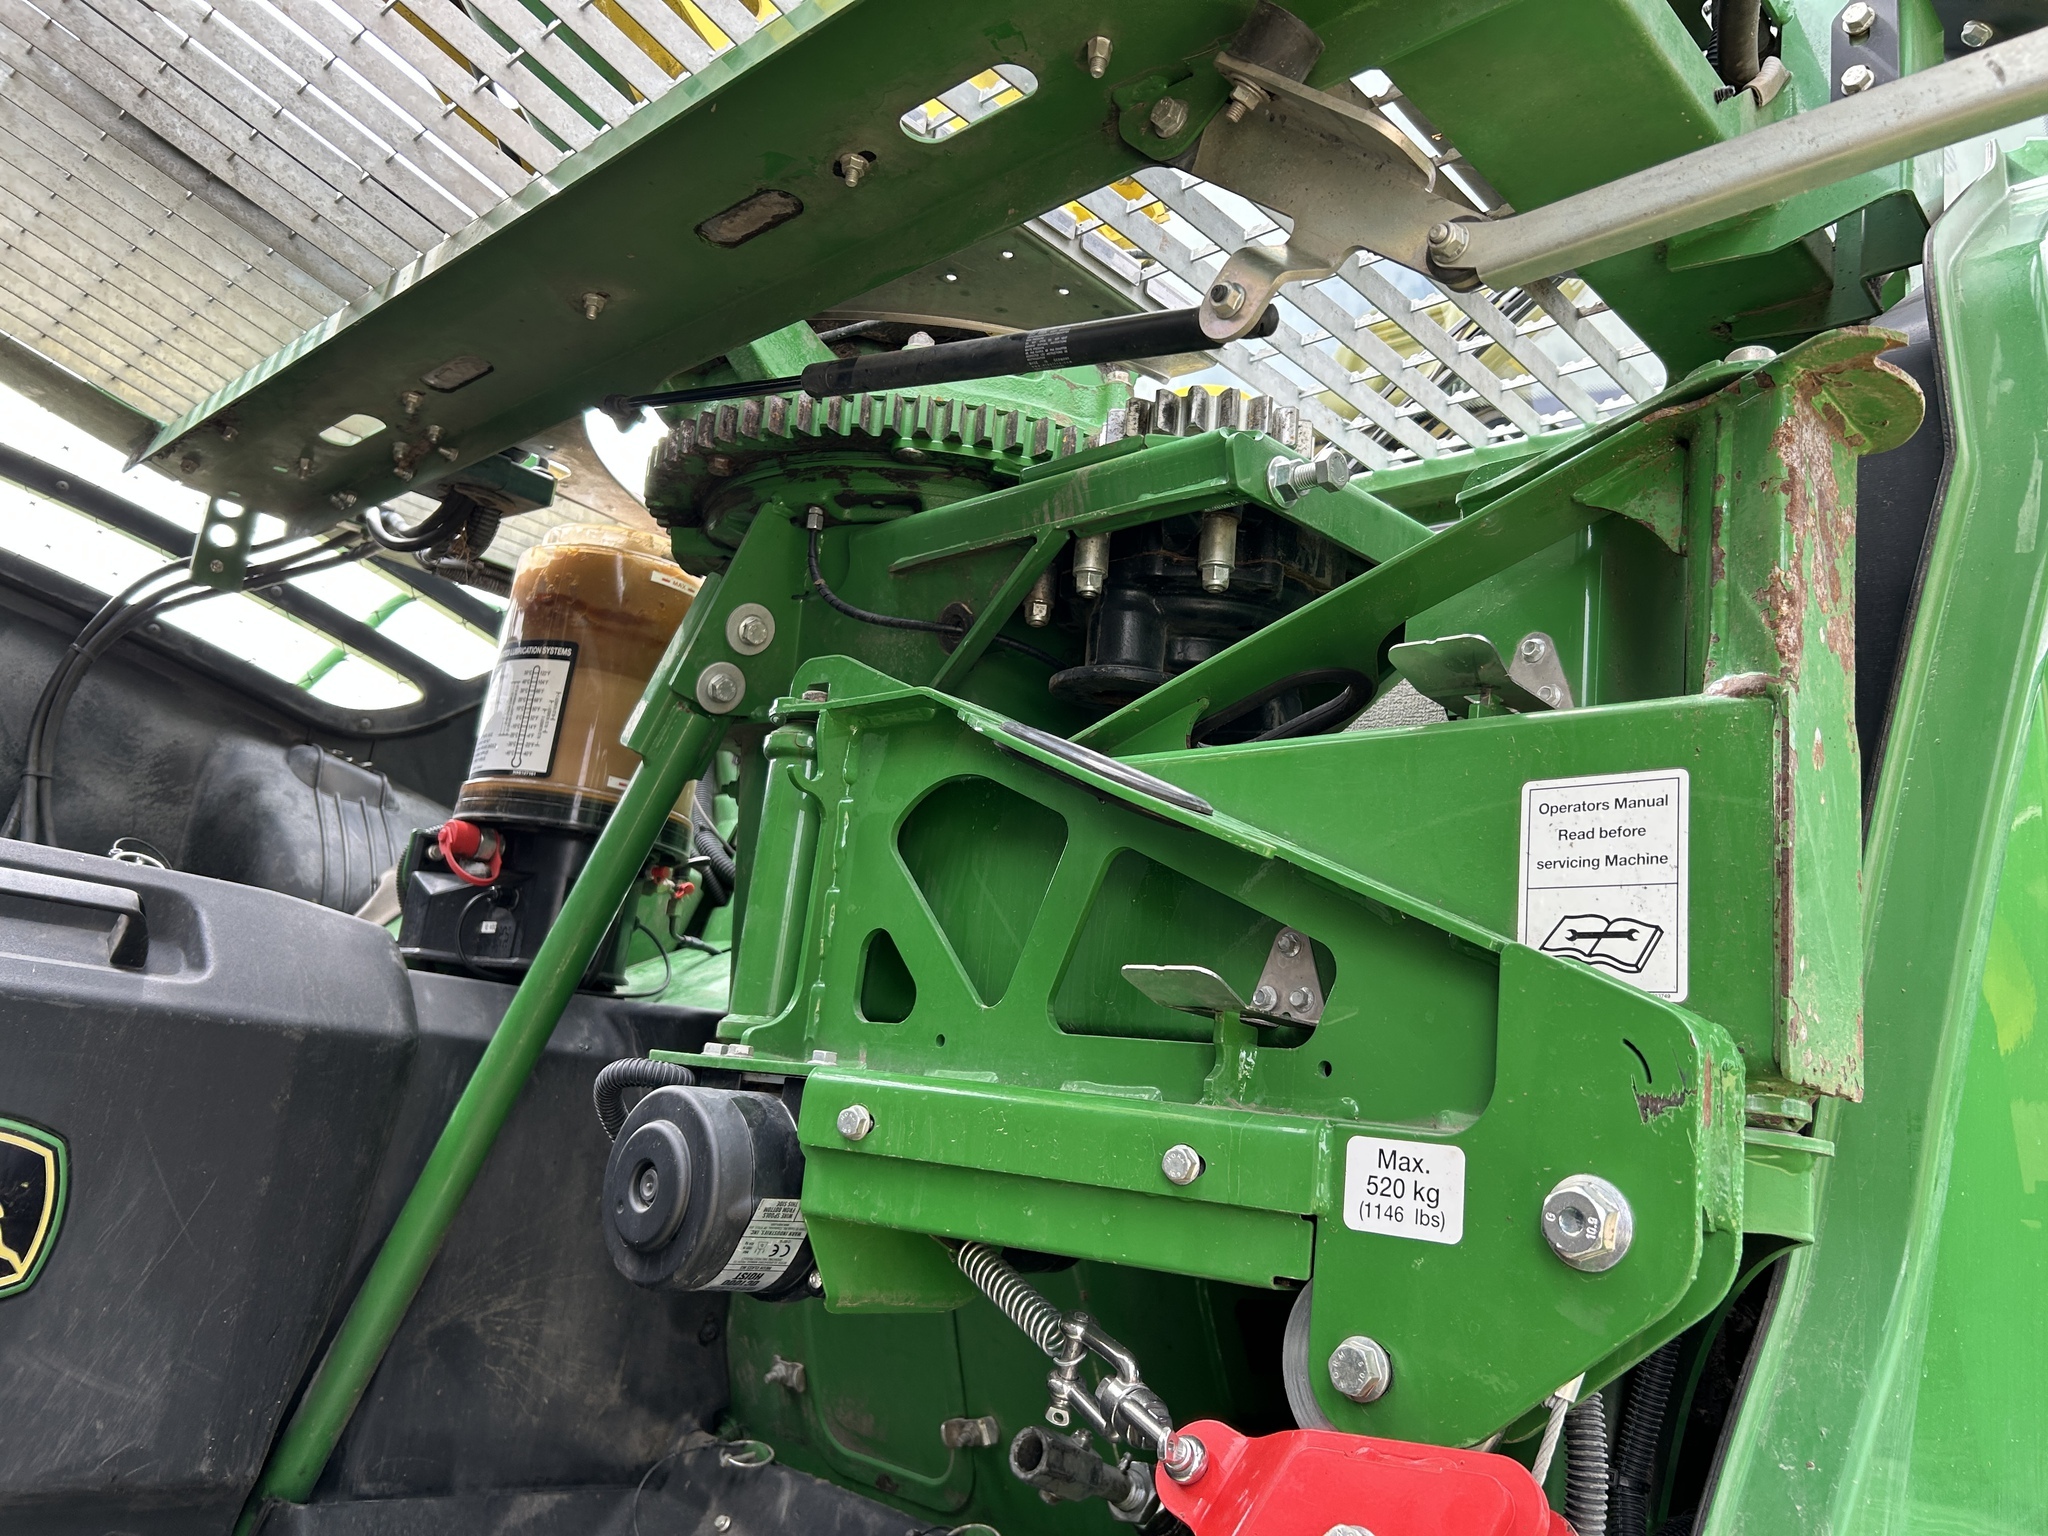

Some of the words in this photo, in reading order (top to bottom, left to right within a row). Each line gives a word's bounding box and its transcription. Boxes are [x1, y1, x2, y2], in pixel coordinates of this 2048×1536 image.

[542, 646, 572, 657] SYSTEMS
[1538, 800, 1610, 817] Operators
[1614, 794, 1669, 810] Manual
[1558, 827, 1595, 841] Read
[1599, 826, 1647, 839] before
[1536, 856, 1600, 870] servicing
[1605, 853, 1669, 867] Machine
[1378, 1148, 1430, 1175] Max.
[1366, 1175, 1405, 1199] 520
[1413, 1180, 1440, 1209] kg
[1359, 1200, 1404, 1223] (1146
[1415, 1208, 1446, 1233] lbs)
[1586, 1217, 1598, 1240] 10.9
[732, 1272, 765, 1280] HOIST
